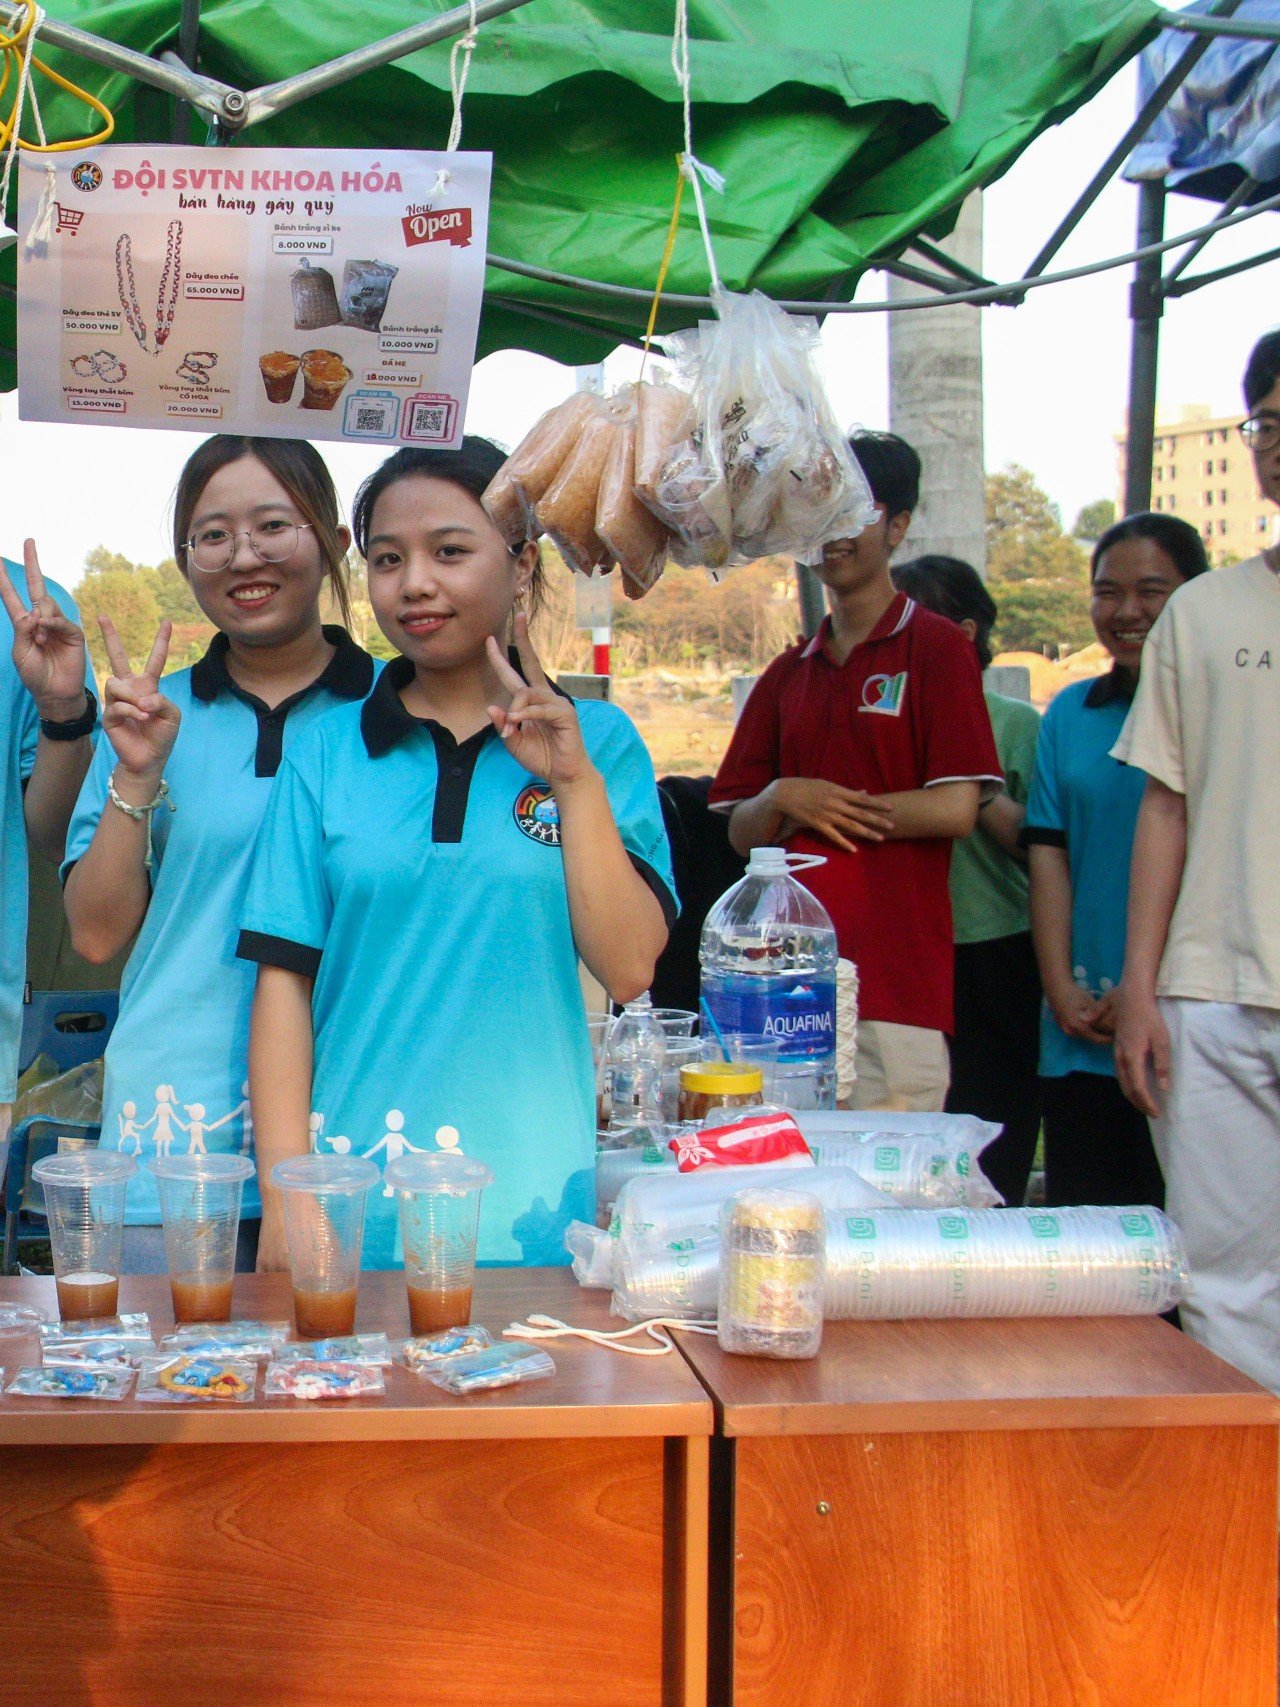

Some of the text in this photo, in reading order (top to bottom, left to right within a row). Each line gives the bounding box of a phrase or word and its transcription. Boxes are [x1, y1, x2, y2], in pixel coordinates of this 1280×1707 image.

[112, 159, 403, 197] ĐỘI SVTN KHOA HÓA
[178, 193, 336, 217] bán hàng gây quỹ
[406, 203, 433, 217] Now
[274, 223, 296, 231] Bánh
[298, 223, 321, 233] tráng
[410, 212, 463, 241] Open
[278, 241, 305, 249] 8.000
[186, 271, 203, 280] Dây
[187, 286, 218, 294] 65.000
[66, 322, 98, 330] 50.000
[382, 324, 404, 332] Bánh
[405, 325, 429, 334] tráng
[381, 340, 413, 348] 10.000
[72, 400, 101, 408] 15.000
[167, 405, 198, 413] 20.000
[762, 1011, 833, 1037] AQUAFINA
